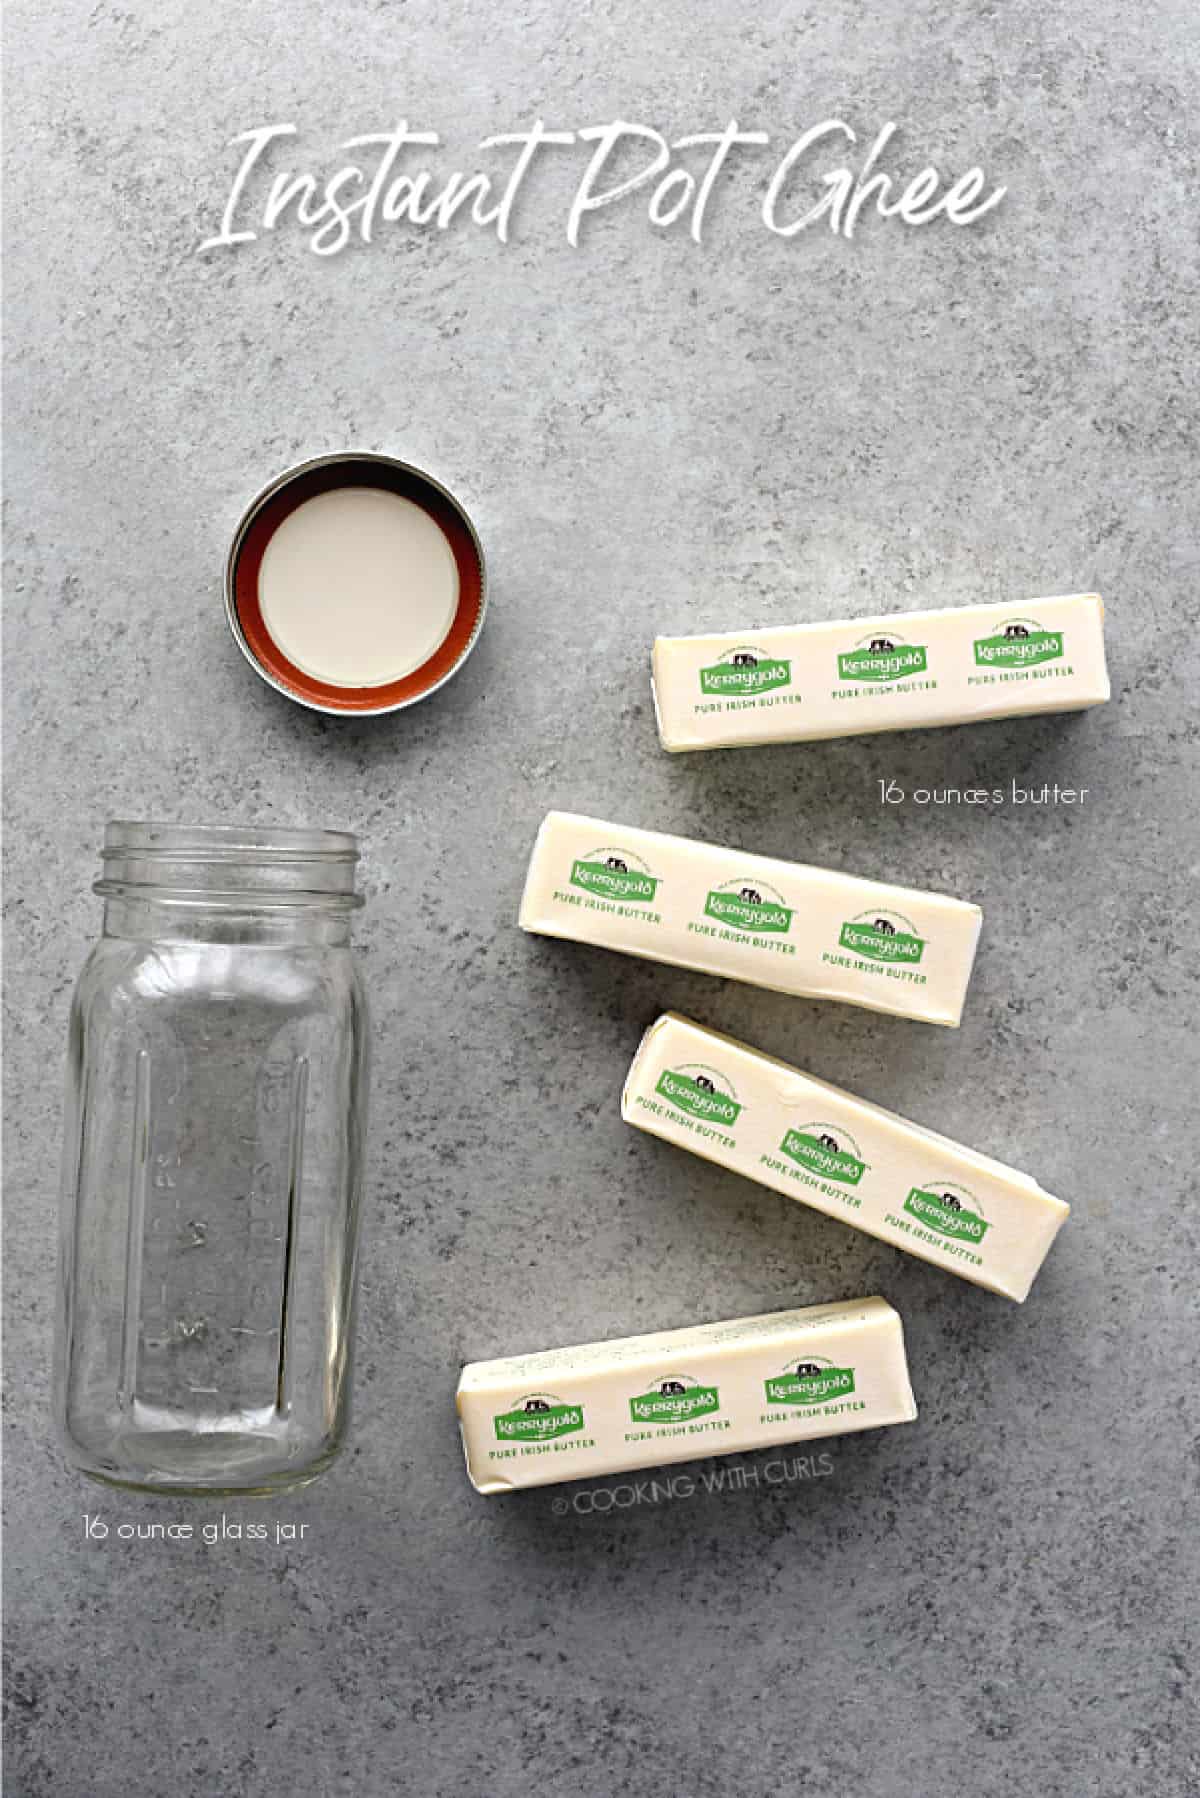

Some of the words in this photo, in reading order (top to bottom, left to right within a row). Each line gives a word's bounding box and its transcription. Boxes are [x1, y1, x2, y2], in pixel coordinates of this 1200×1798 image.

[832, 688, 860, 700] PURE
[863, 685, 894, 697] IRISH
[896, 680, 938, 694] BUTTER
[967, 674, 996, 686] PURE
[999, 671, 1028, 684] IRISH
[1030, 667, 1075, 680] BUTTER
[694, 703, 722, 714] PURE
[726, 699, 756, 711] IRISH
[759, 695, 802, 708] BUTTER
[553, 891, 582, 905] PURE
[585, 898, 616, 913] IRISH
[617, 905, 661, 924] BUTTER
[688, 922, 716, 938] PURE
[718, 928, 749, 945] IRISH
[750, 935, 796, 955] BUTTER
[822, 952, 851, 967] PURE
[852, 959, 883, 975] IRISH
[885, 966, 927, 985] BUTTER
[636, 1096, 666, 1115] PURE
[664, 1110, 696, 1130] IRISH
[694, 1121, 736, 1149] BUTTER
[760, 1154, 790, 1175] PURE
[789, 1169, 819, 1189] IRISH
[818, 1180, 861, 1209] BUTTER
[884, 1213, 914, 1233] PURE
[912, 1226, 944, 1248] IRISH
[943, 1238, 983, 1266] BUTTER
[760, 1413, 788, 1424] PURE
[790, 1408, 821, 1420] IRISH
[823, 1402, 866, 1417] BUTTER
[624, 1431, 652, 1442] PURE
[656, 1426, 688, 1438] IRISH
[688, 1420, 731, 1434] BUTTER
[488, 1449, 517, 1460] PURE
[520, 1445, 551, 1456] IRISH
[552, 1439, 596, 1453] BUTTER
